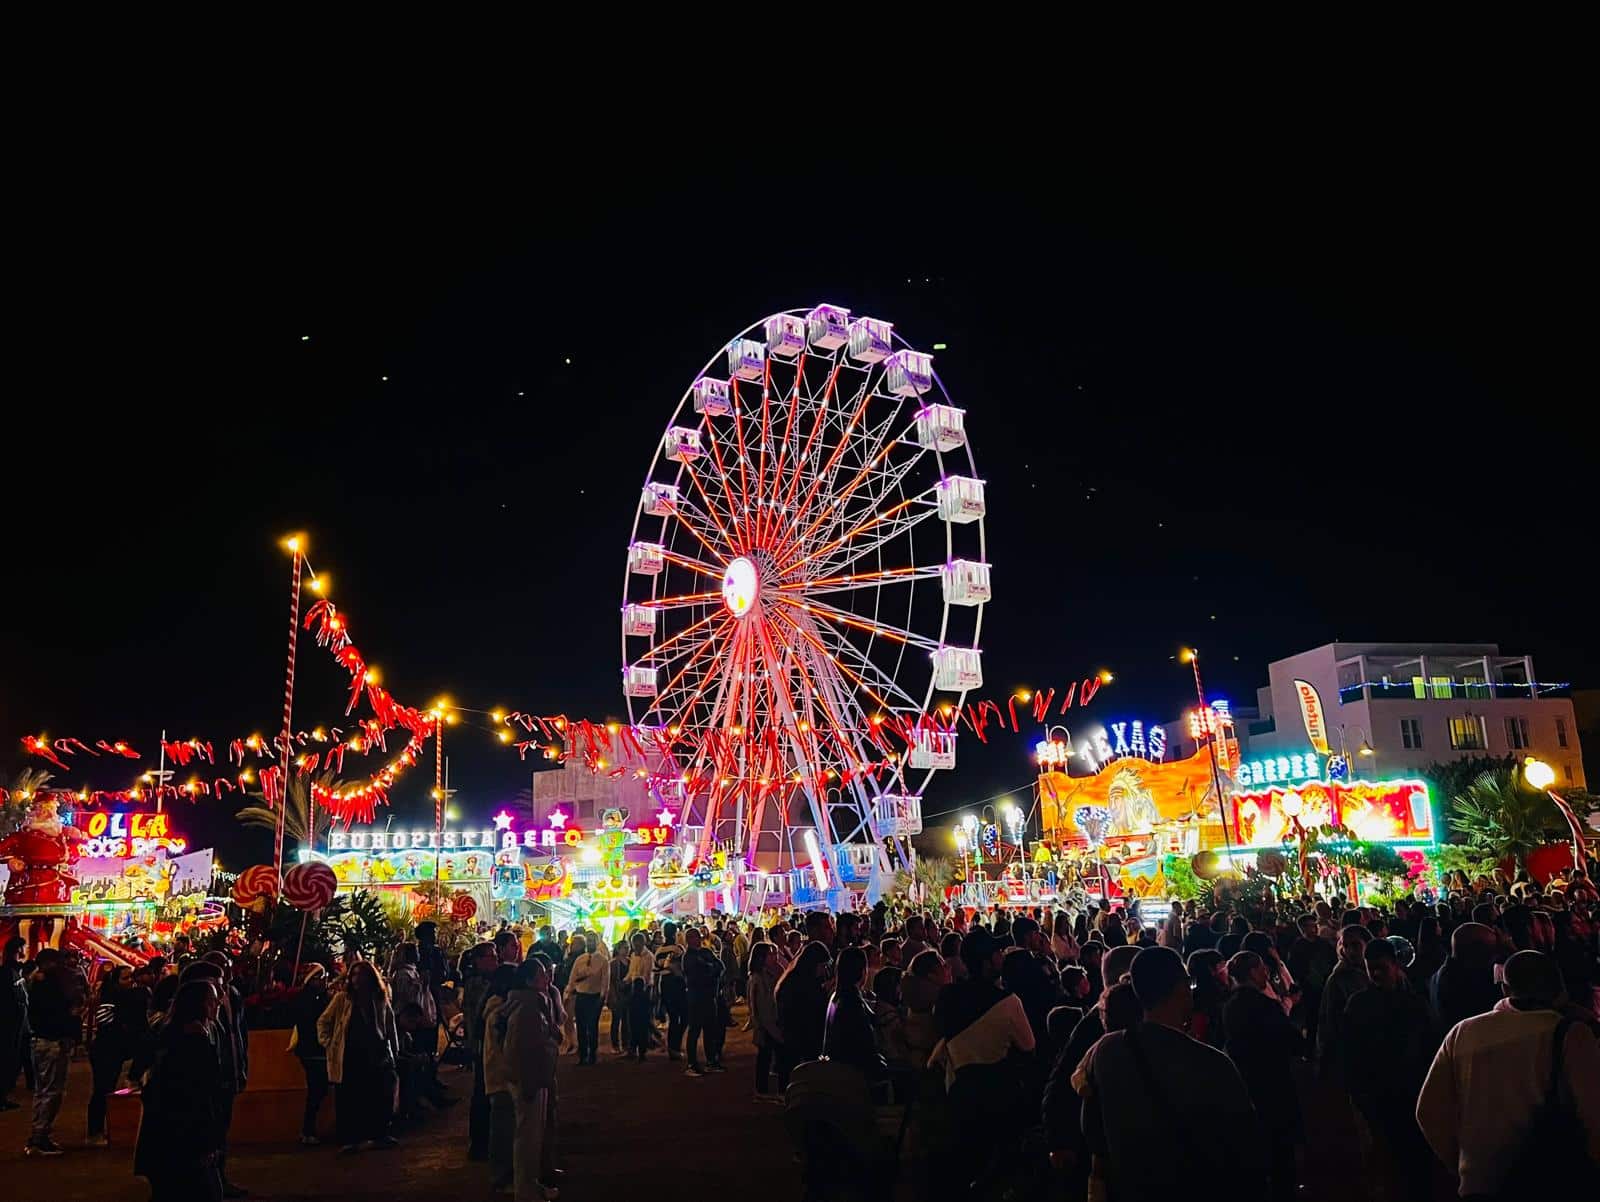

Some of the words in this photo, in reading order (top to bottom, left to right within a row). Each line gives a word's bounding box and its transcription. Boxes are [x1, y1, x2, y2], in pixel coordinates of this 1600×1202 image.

[1080, 720, 1167, 771] TEXAS
[1238, 753, 1319, 785] CREPES
[330, 831, 494, 849] EUROPISTA
[502, 828, 582, 848] AERO
